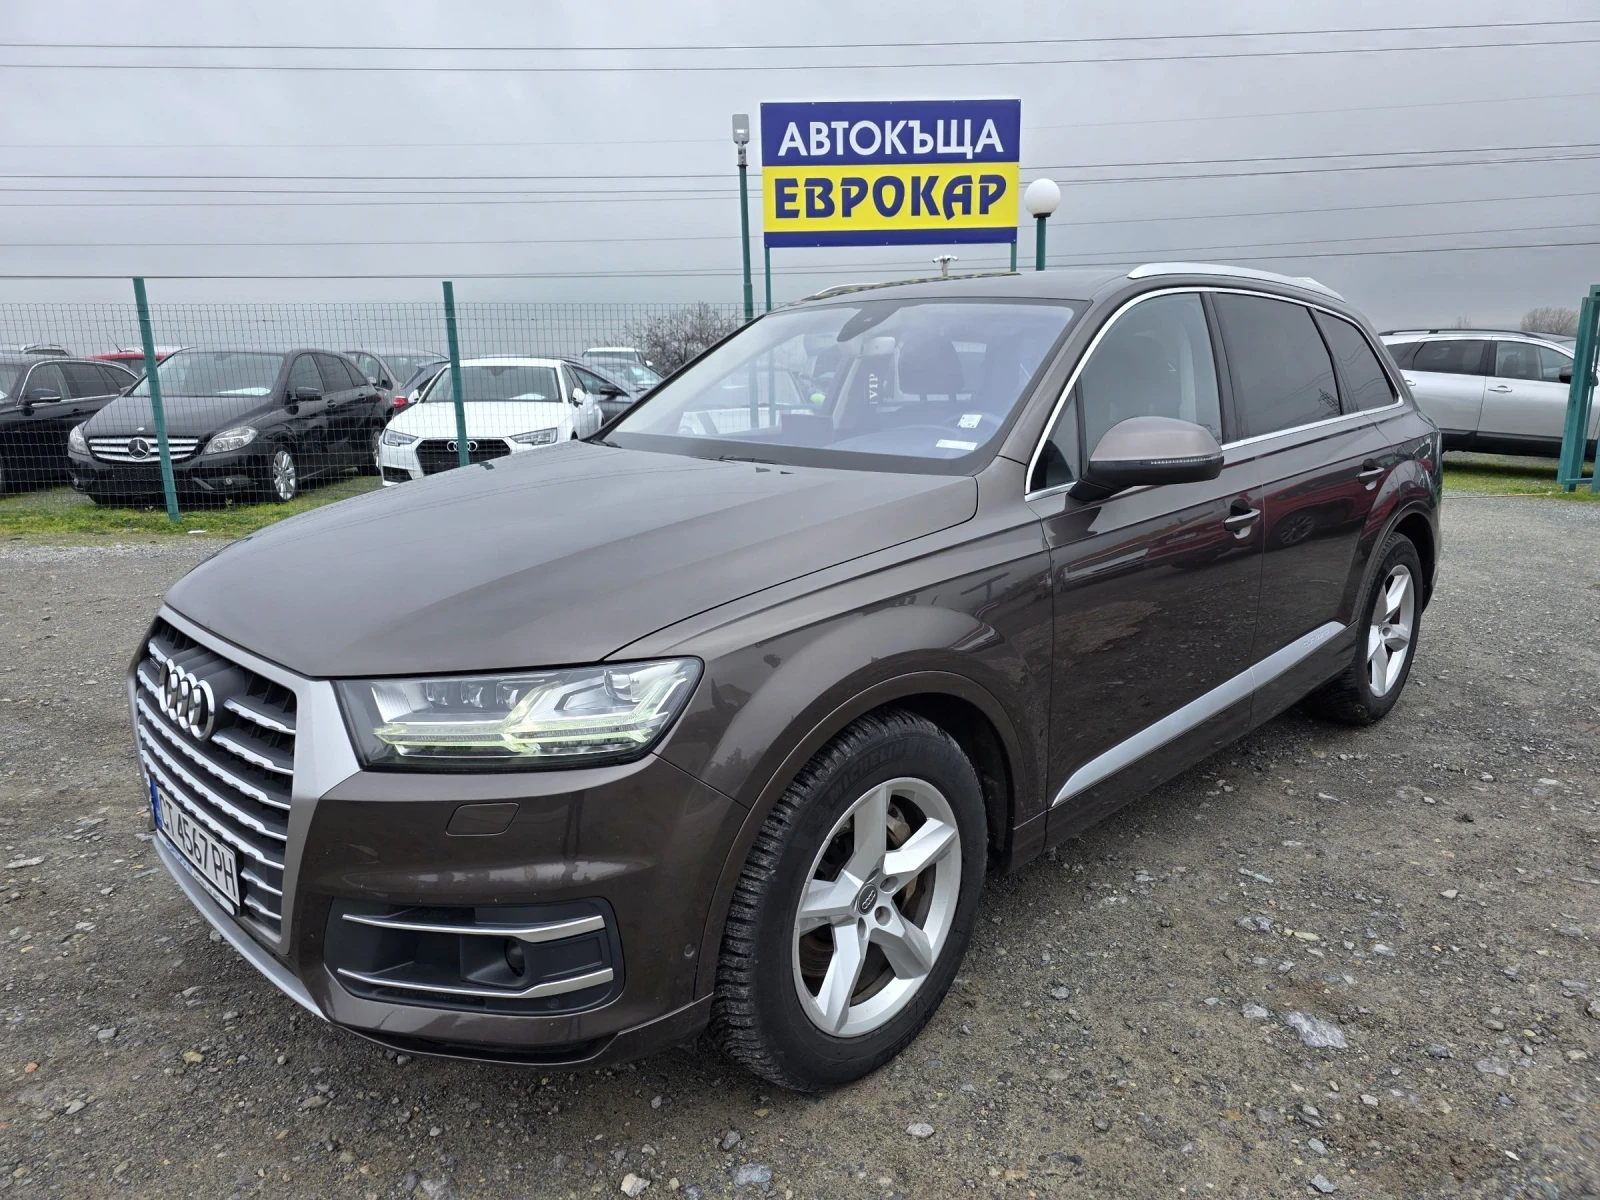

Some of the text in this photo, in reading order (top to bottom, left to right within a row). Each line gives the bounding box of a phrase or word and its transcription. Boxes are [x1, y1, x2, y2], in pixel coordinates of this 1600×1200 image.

[777, 119, 1004, 159] АВТОКЪЩА
[774, 174, 1007, 220] ЕВРОКАР
[160, 794, 174, 837] CT
[177, 811, 208, 871] 4567
[212, 843, 236, 897] PH
